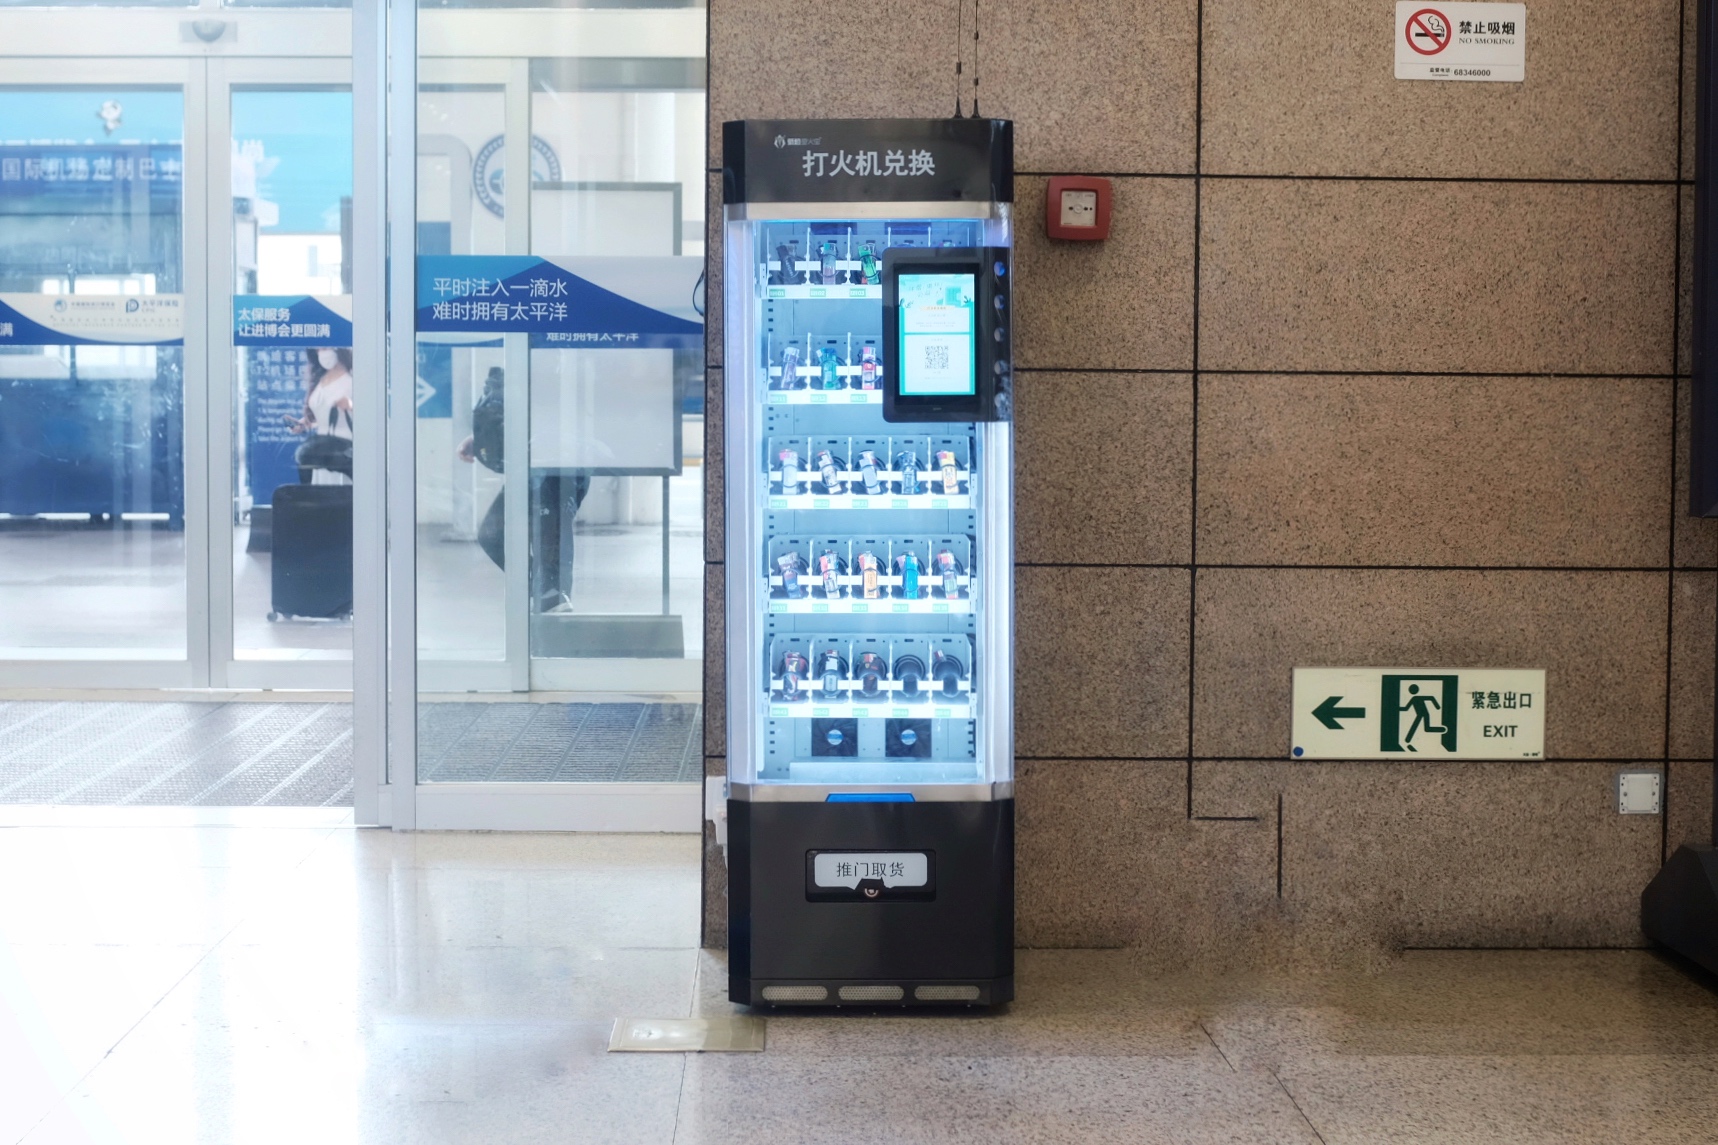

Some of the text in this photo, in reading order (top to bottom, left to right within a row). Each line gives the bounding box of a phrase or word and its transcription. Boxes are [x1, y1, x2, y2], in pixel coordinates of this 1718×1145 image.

[1459, 20, 1515, 35] 禁止吸烟
[1474, 37, 1515, 45] SMOKING
[802, 149, 936, 177] 打火机兑换
[433, 278, 568, 297] 平时注入一滴水
[238, 307, 290, 322] 太保服务
[433, 302, 568, 321] 难时拥有太平洋
[238, 323, 331, 338] 让进博会更圆满
[1471, 691, 1532, 710] 紧急出口
[1483, 725, 1519, 738] EXIT
[836, 862, 905, 878] 推门取货
